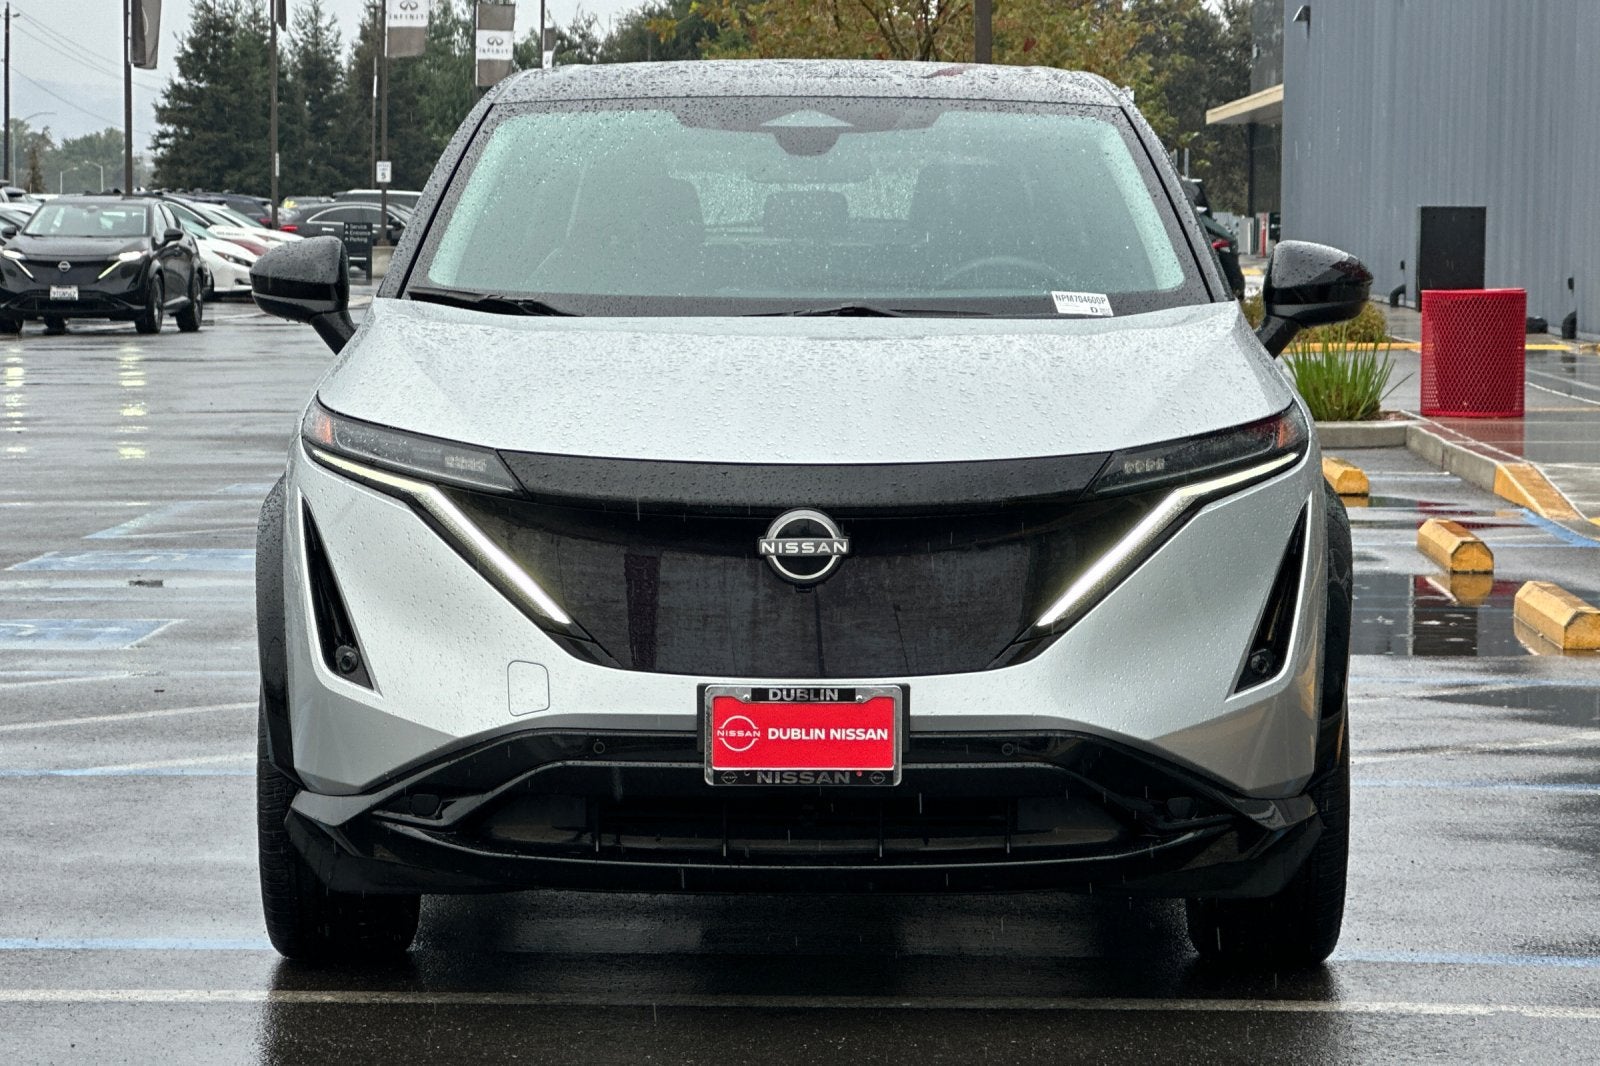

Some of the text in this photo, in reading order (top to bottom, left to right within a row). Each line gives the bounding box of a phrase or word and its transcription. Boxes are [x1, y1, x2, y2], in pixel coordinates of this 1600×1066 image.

[761, 541, 847, 554] NISSAN
[768, 688, 839, 701] DUBLIN
[768, 727, 888, 740] DUBLIN NISSAN
[756, 771, 850, 784] NISSAN
